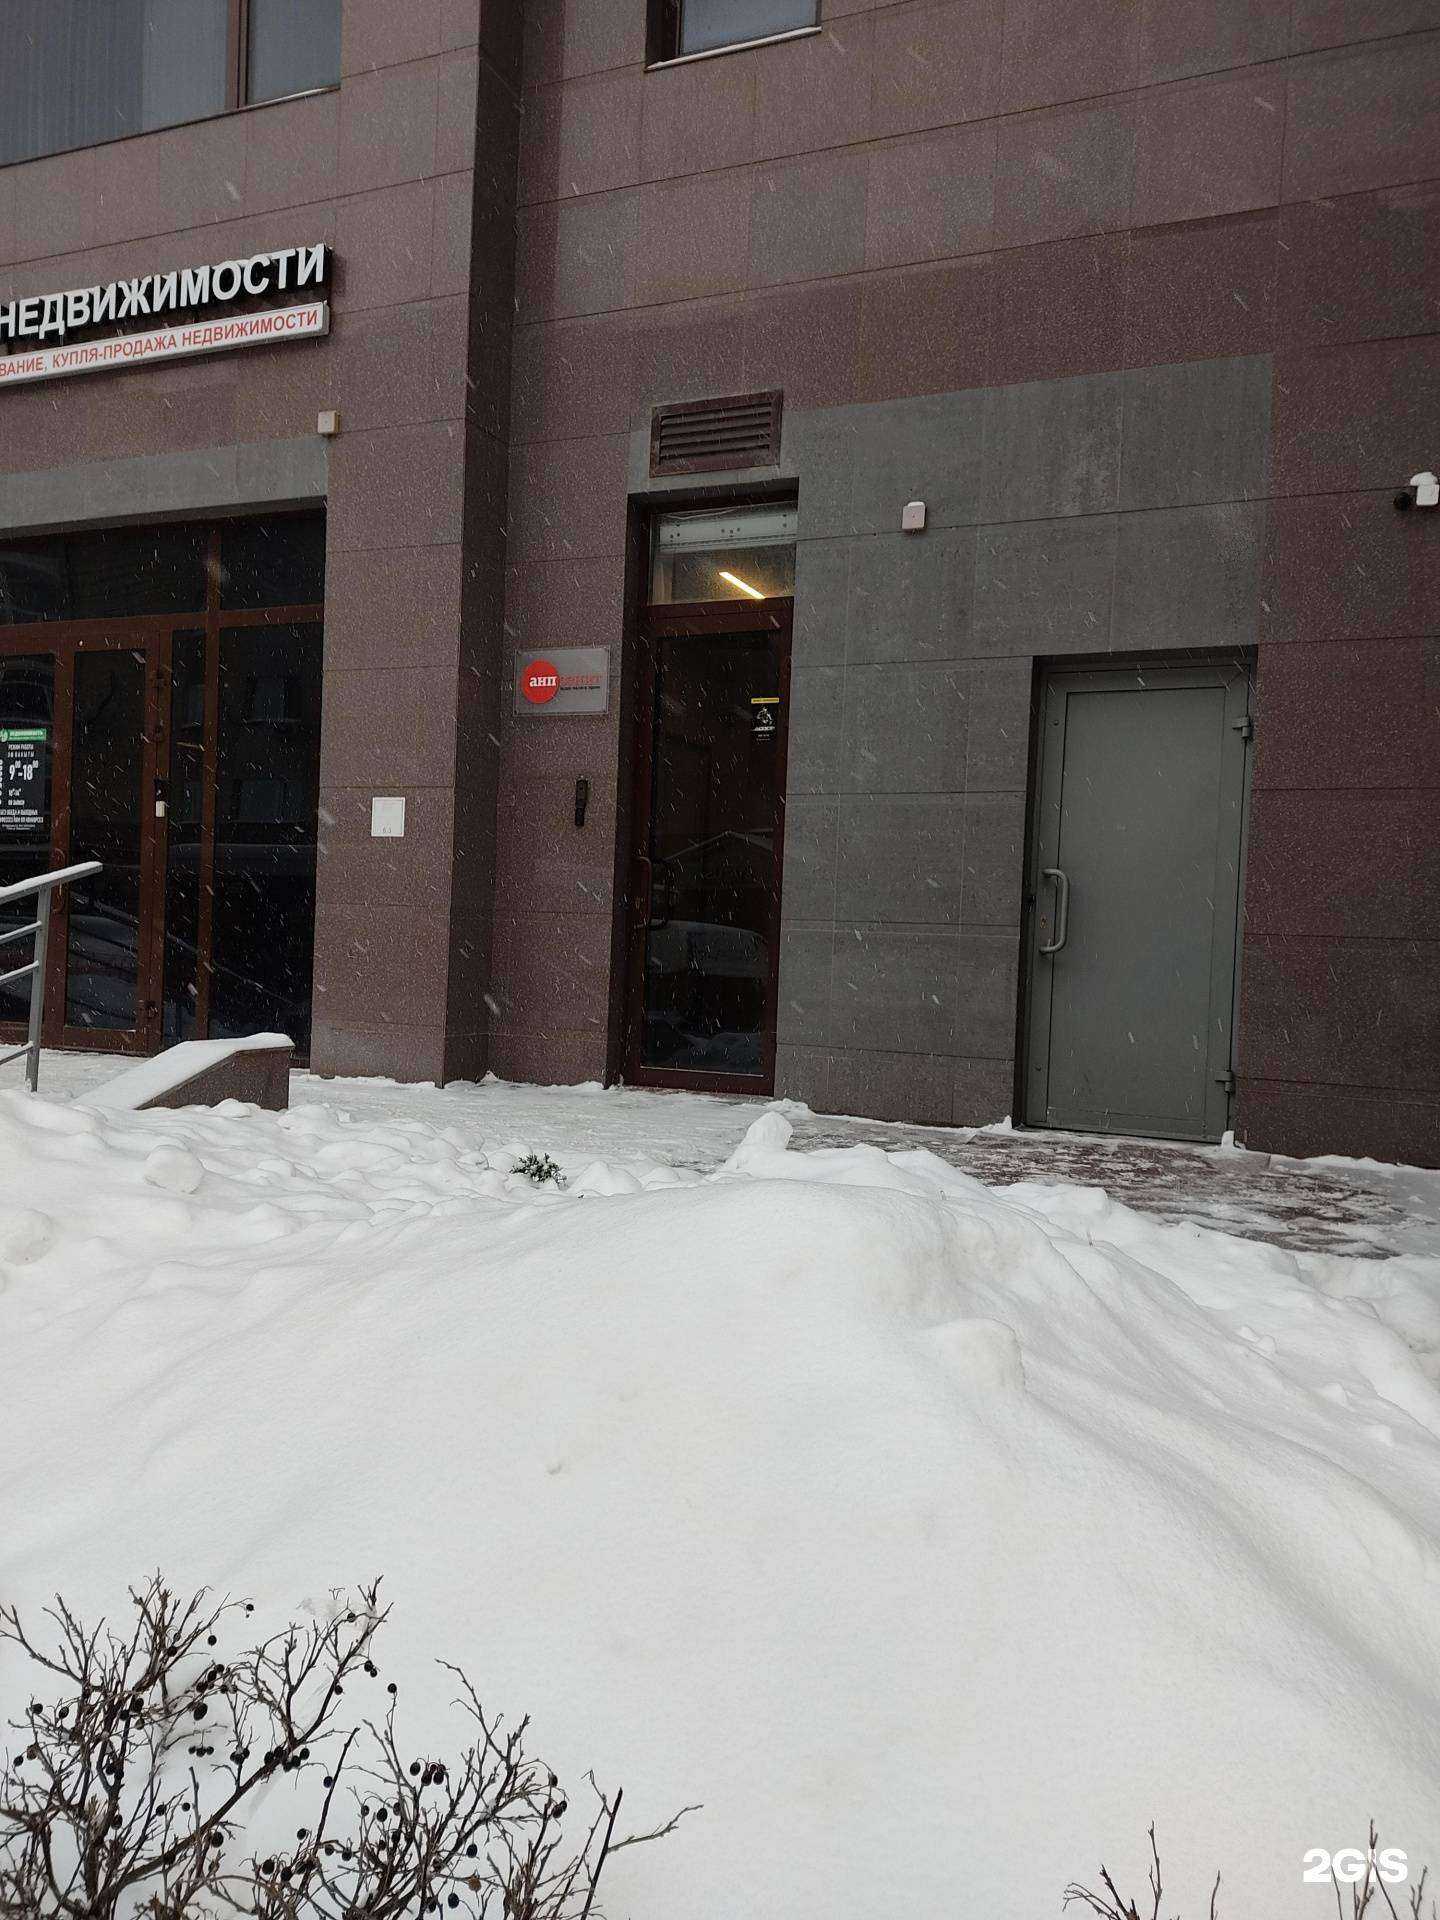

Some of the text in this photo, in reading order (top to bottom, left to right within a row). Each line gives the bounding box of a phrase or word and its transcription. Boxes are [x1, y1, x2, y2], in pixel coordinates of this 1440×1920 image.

[0, 243, 326, 339] НЕДВИЖИМОСТИ
[52, 335, 177, 368] КУПЛЯ-ПРОДАЖА
[182, 310, 318, 347] НЕДВИЖИМОСТИ
